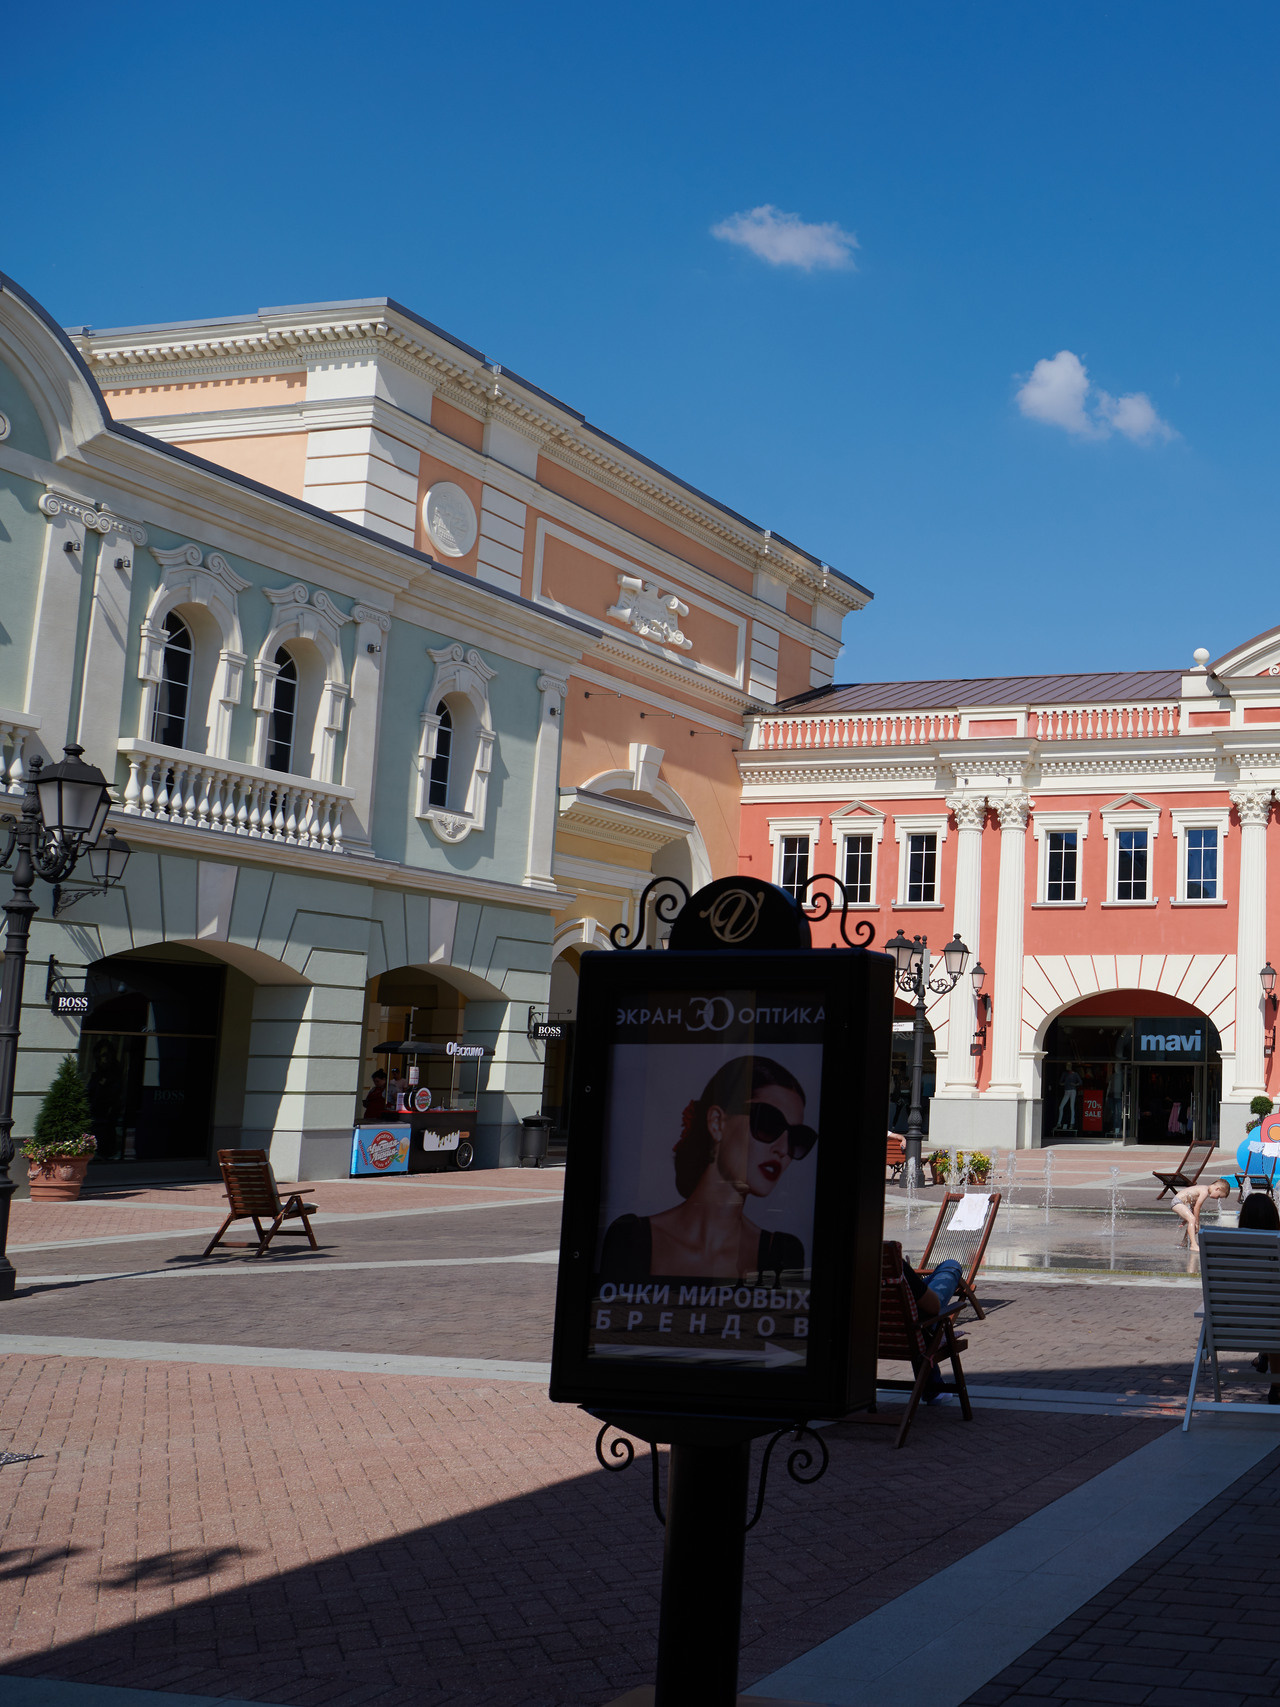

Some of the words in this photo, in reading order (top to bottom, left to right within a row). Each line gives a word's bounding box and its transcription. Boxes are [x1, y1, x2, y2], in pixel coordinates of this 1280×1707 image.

[58, 996, 88, 1008] BOSS
[616, 1007, 683, 1025] ЭКРАН
[738, 1006, 827, 1025] ОПТИКА
[538, 1026, 561, 1034] BOSS
[1140, 1029, 1202, 1052] mavi
[153, 1089, 185, 1101] BOSS
[1084, 1110, 1102, 1118] SALE
[599, 1282, 670, 1305] ОЧКИ
[678, 1286, 810, 1311] МИРОВЫХ
[595, 1309, 810, 1340] БРЕНДОВ
